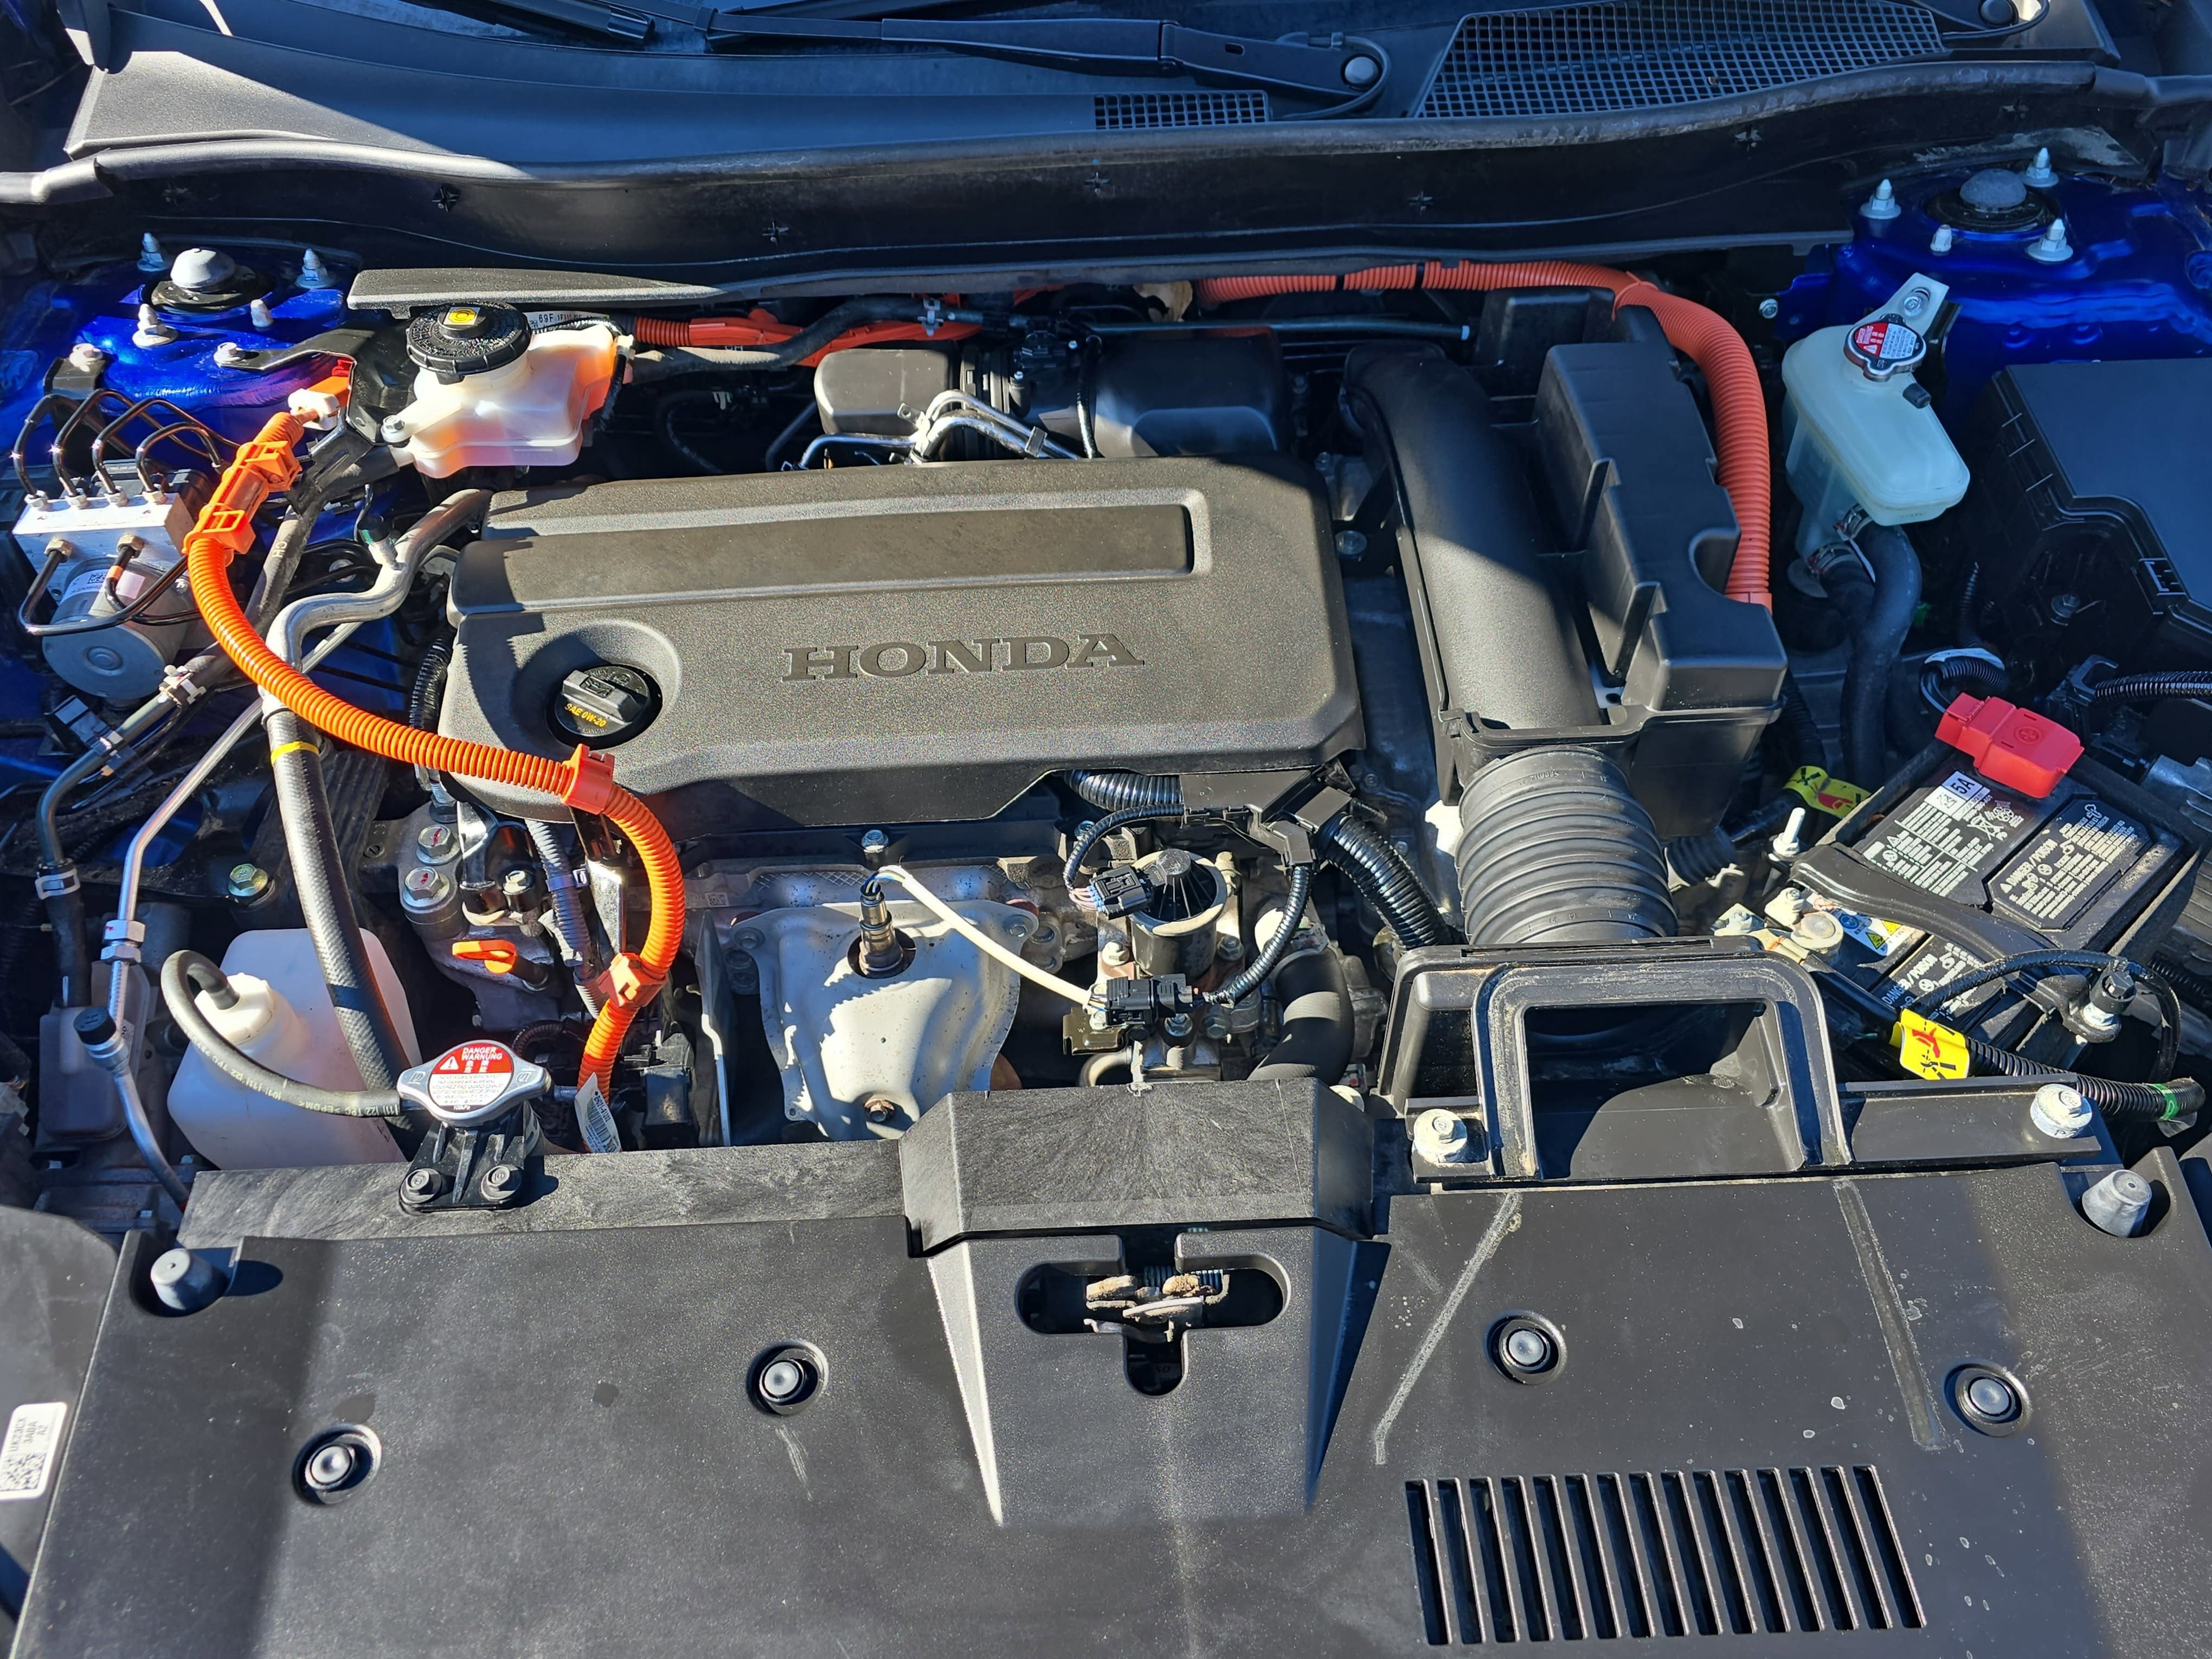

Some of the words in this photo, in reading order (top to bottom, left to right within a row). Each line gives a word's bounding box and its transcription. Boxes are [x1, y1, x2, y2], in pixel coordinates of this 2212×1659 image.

[539, 313, 554, 323] 69F
[272, 541, 288, 558] CH
[780, 633, 1145, 683] HONDA
[565, 703, 583, 716] SAE
[581, 711, 607, 727] 0W-20
[1950, 778, 1975, 794] 5A
[2009, 839, 2058, 888] DANGER/POISON
[1882, 953, 1938, 1005] DANGER/POISON
[345, 1108, 363, 1117] TPC
